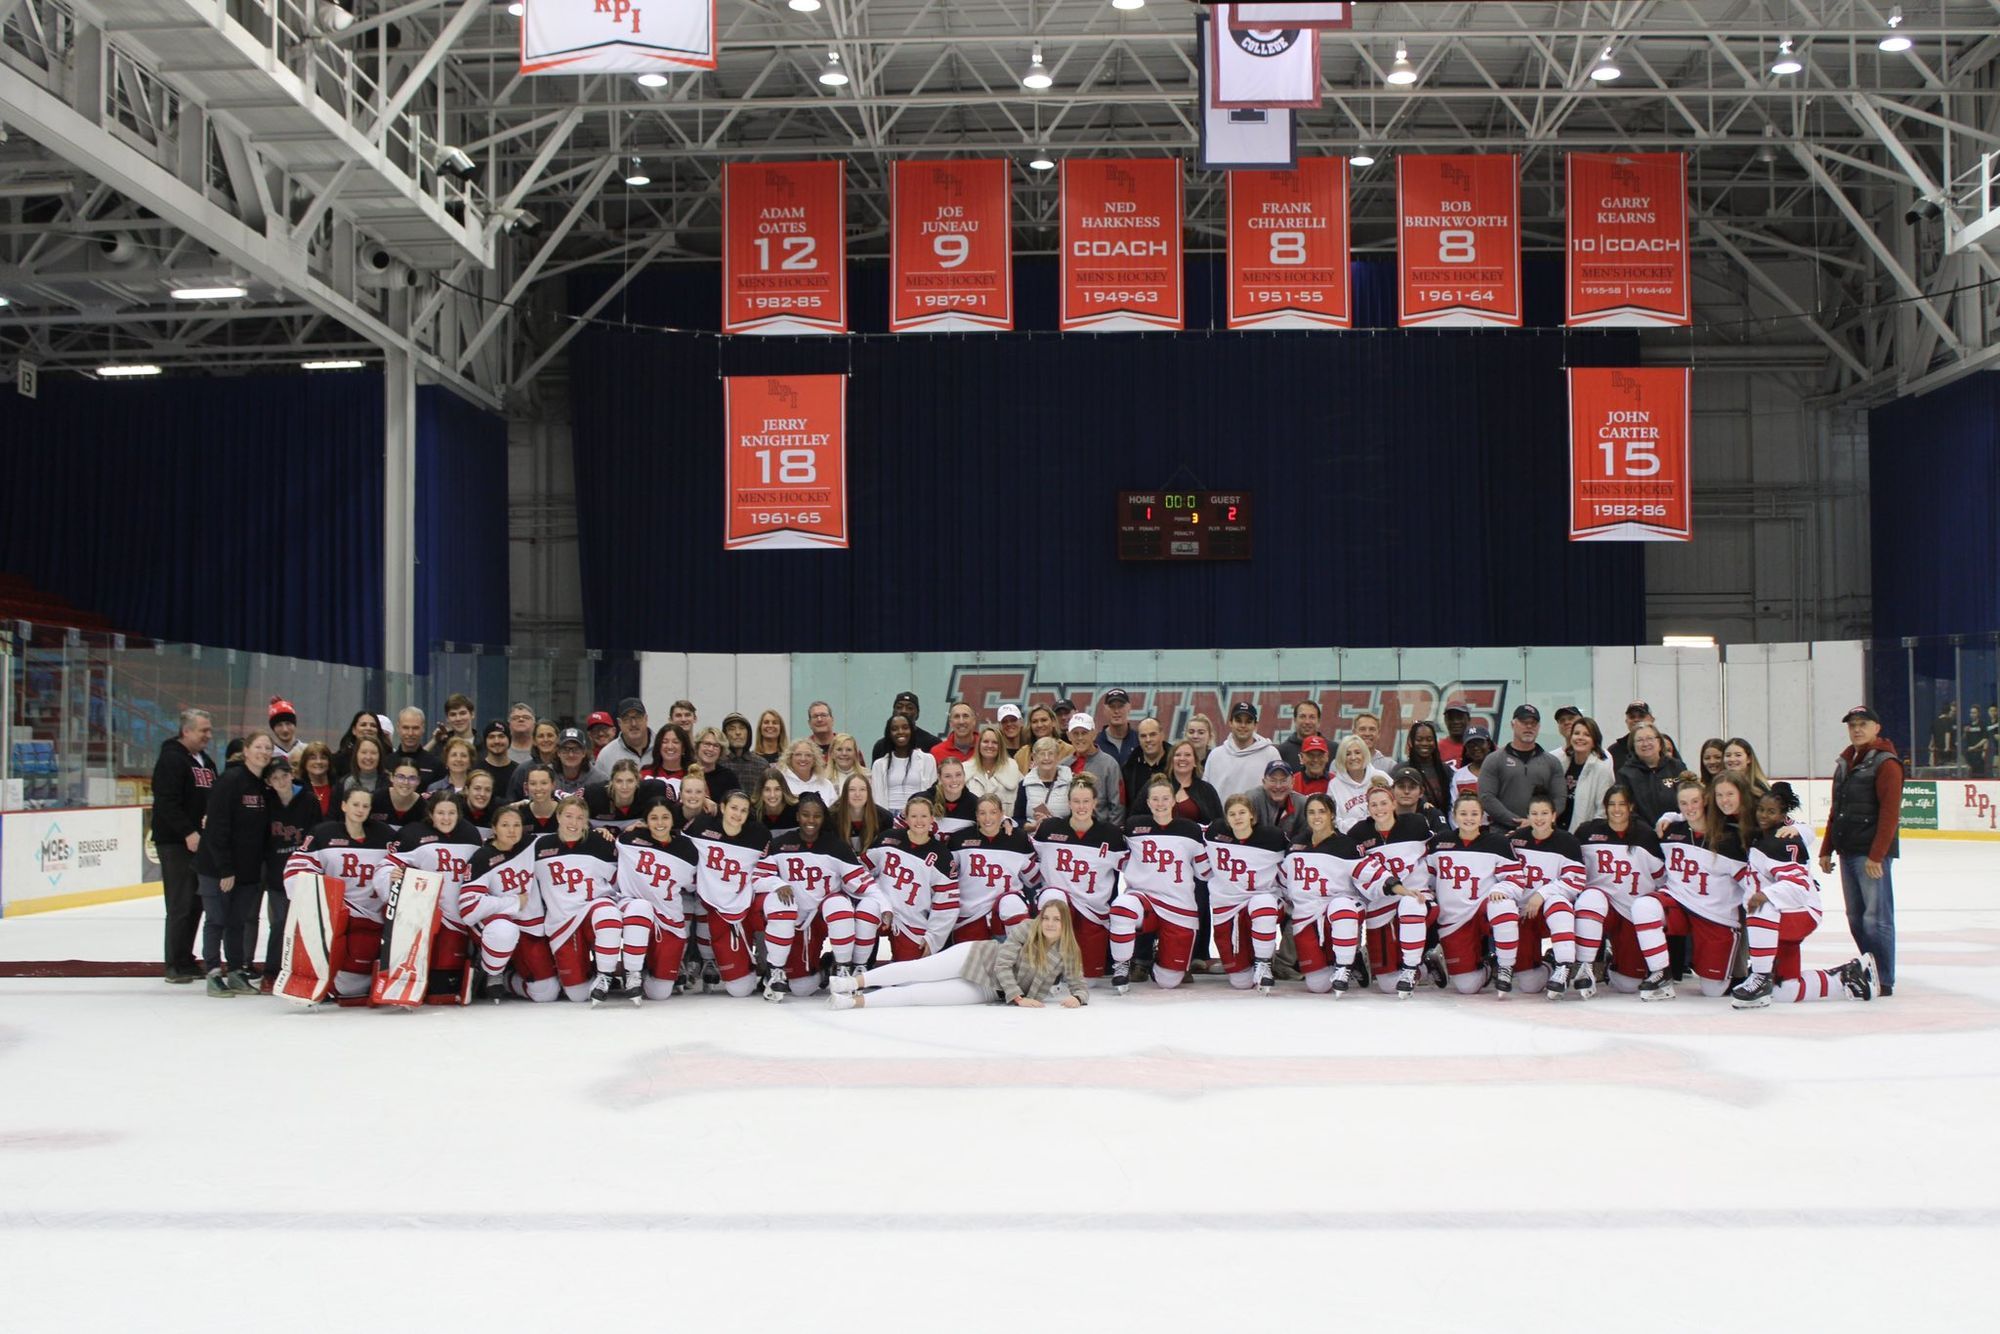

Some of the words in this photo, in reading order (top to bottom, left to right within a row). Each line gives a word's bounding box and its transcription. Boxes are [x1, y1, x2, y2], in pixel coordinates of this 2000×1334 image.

[593, 0, 641, 33] RPI
[1240, 36, 1289, 56] COLLEGE
[1104, 202, 1136, 213] NED
[1262, 203, 1312, 214] FRANK
[1440, 201, 1472, 212] BOB
[1601, 197, 1651, 210] GARRY
[760, 207, 805, 218] ADAM
[936, 206, 963, 220] JOE
[1597, 212, 1656, 224] KEARNS
[758, 222, 807, 234] OATES
[921, 221, 979, 235] JUNEAU
[1081, 217, 1160, 228] HARKNESS
[1248, 217, 1326, 229] CHIARELLI
[1404, 216, 1508, 227] BRINKWORTH
[933, 234, 970, 268] 9
[1073, 240, 1168, 256] COACH
[1269, 231, 1306, 265] 8
[1439, 230, 1476, 263] 8
[1572, 239, 1595, 252] 10
[1606, 238, 1680, 252] COACH
[753, 237, 818, 271] 12
[1076, 271, 1115, 282] MEN'S
[1118, 270, 1168, 282] HOCKEY
[1243, 271, 1280, 282] MEN'S
[1284, 270, 1334, 282] HOCKEY
[1412, 270, 1450, 281] MEN'S
[1453, 270, 1504, 281] HOCKEY
[1581, 268, 1619, 278] MEN'S
[1622, 267, 1673, 278] HOCKEY
[737, 276, 775, 288] MEN'S
[779, 275, 830, 287] HOCKEY
[905, 275, 944, 287] MEN'S
[950, 274, 997, 286] HOCKEY
[746, 296, 822, 308] 1982-85
[915, 295, 987, 306] 1987-91
[1083, 291, 1158, 303] 1949-63
[1248, 291, 1323, 302] 1951-55
[1419, 290, 1495, 301] 1961-64
[1606, 411, 1650, 425] JOHN
[761, 418, 808, 433] JERRY
[1599, 427, 1660, 439] CARTER
[740, 434, 830, 447] KNIGHTLEY
[1598, 441, 1661, 477] 15
[755, 449, 816, 484] 18
[1582, 485, 1621, 495] MEN'S
[1624, 485, 1675, 495] HOCKEY
[737, 492, 777, 503] MEN'S
[780, 492, 831, 502] HOCKEY
[1129, 496, 1155, 504] HOME
[1211, 496, 1240, 504] GUEST
[1147, 507, 1151, 520] 1
[1228, 507, 1237, 521] 2
[1593, 505, 1666, 516] 1982-86
[751, 512, 822, 524] 1961-65
[1192, 513, 1199, 524] 3
[192, 767, 216, 788] RP
[1964, 784, 1996, 829] RPI
[78, 838, 118, 854] RENSSELAER
[1099, 842, 1109, 858] A
[1786, 844, 1799, 862] 7
[78, 854, 101, 868] DINING
[435, 848, 467, 882] RP
[924, 852, 938, 867] C
[1141, 840, 1184, 883] RPI
[341, 853, 378, 898] RP
[635, 850, 677, 901] RPI
[706, 846, 748, 893] RPI
[969, 854, 1012, 892] RPI
[1056, 848, 1097, 893] RPI
[1216, 847, 1257, 891] RPI
[1596, 849, 1641, 896] RPI
[1669, 847, 1710, 896] RPI
[498, 867, 534, 894] RP
[547, 861, 594, 902] RPI
[786, 857, 832, 896] RPI
[883, 851, 922, 907] RPI
[1293, 857, 1328, 897] RPI
[1438, 855, 1480, 900] RPI
[386, 878, 402, 920] CCM
